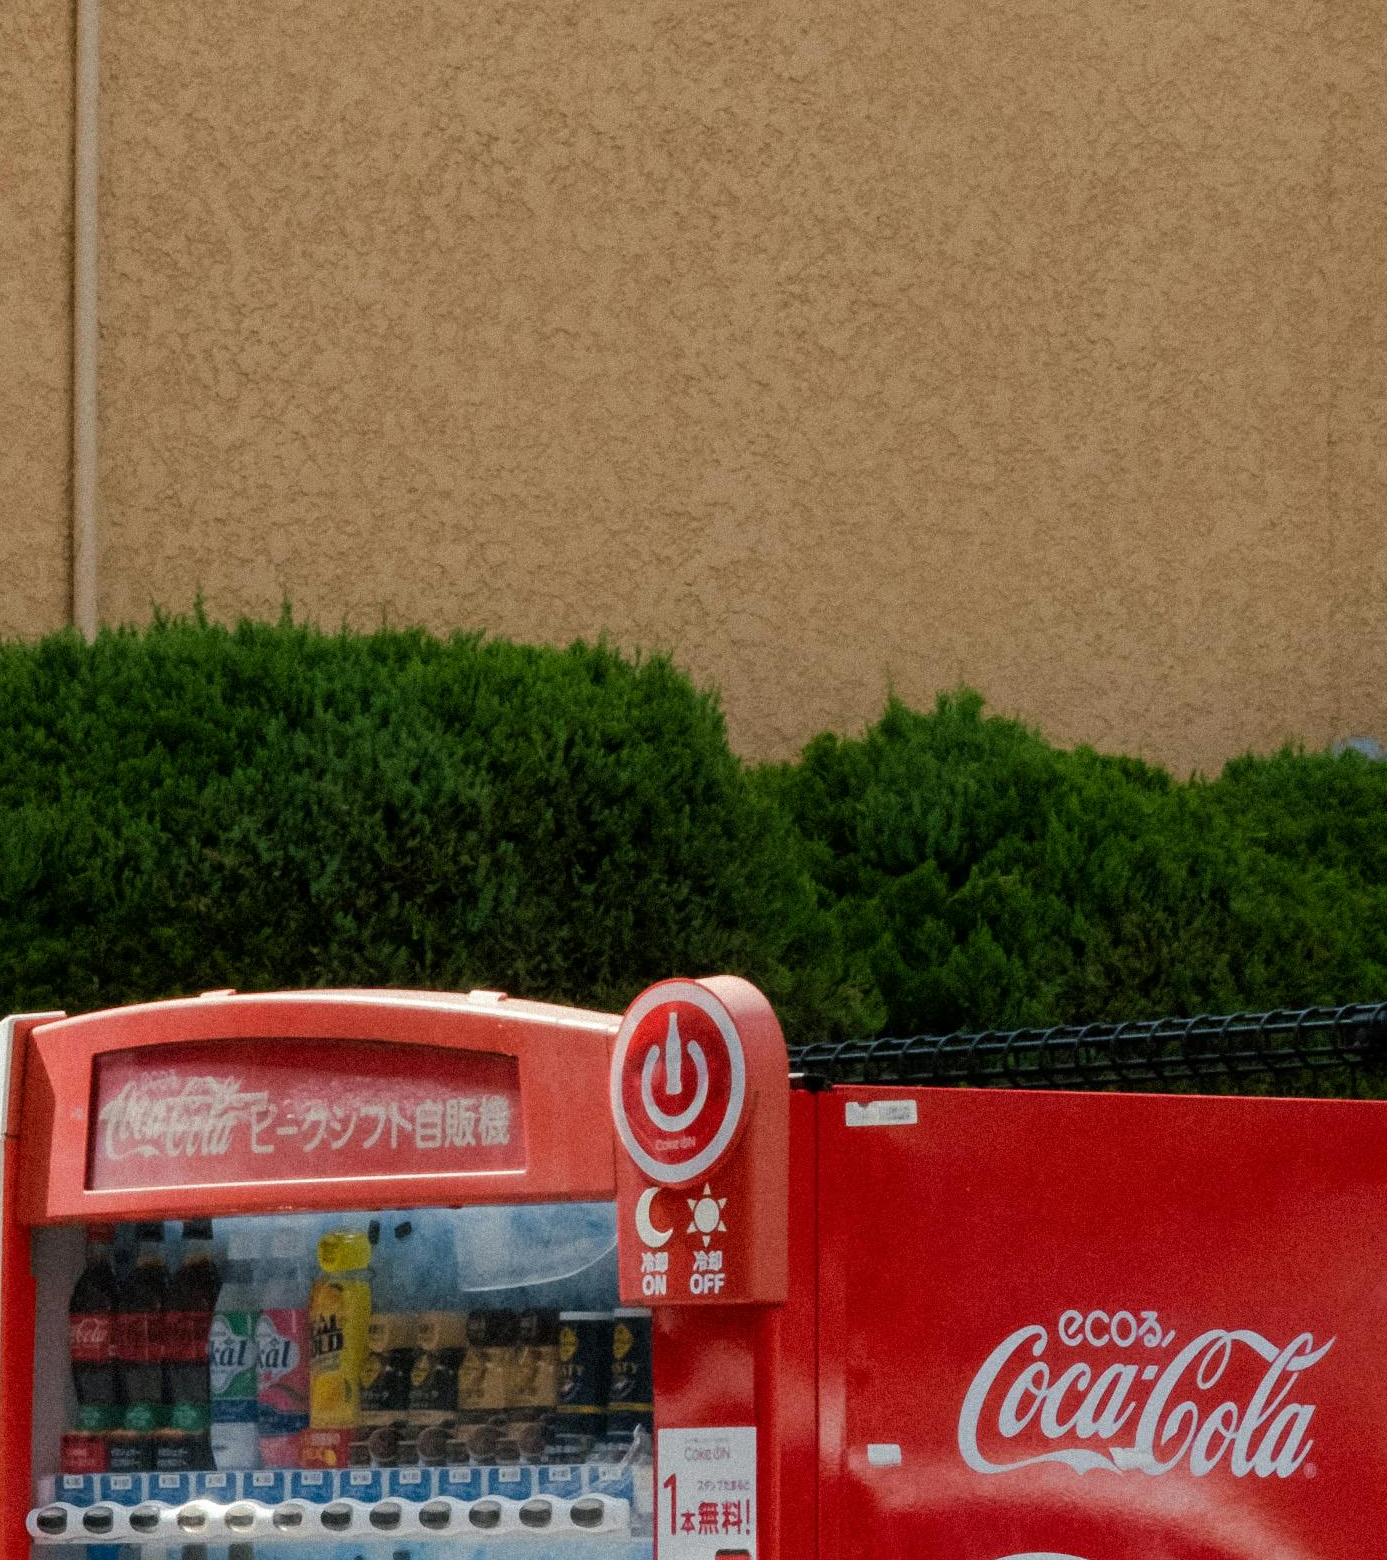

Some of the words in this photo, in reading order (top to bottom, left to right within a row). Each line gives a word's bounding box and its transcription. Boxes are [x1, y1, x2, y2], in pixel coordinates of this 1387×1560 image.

[642, 1275, 667, 1296] ON
[689, 1273, 725, 1294] OFF
[958, 1324, 1336, 1479] Coca-Cola
